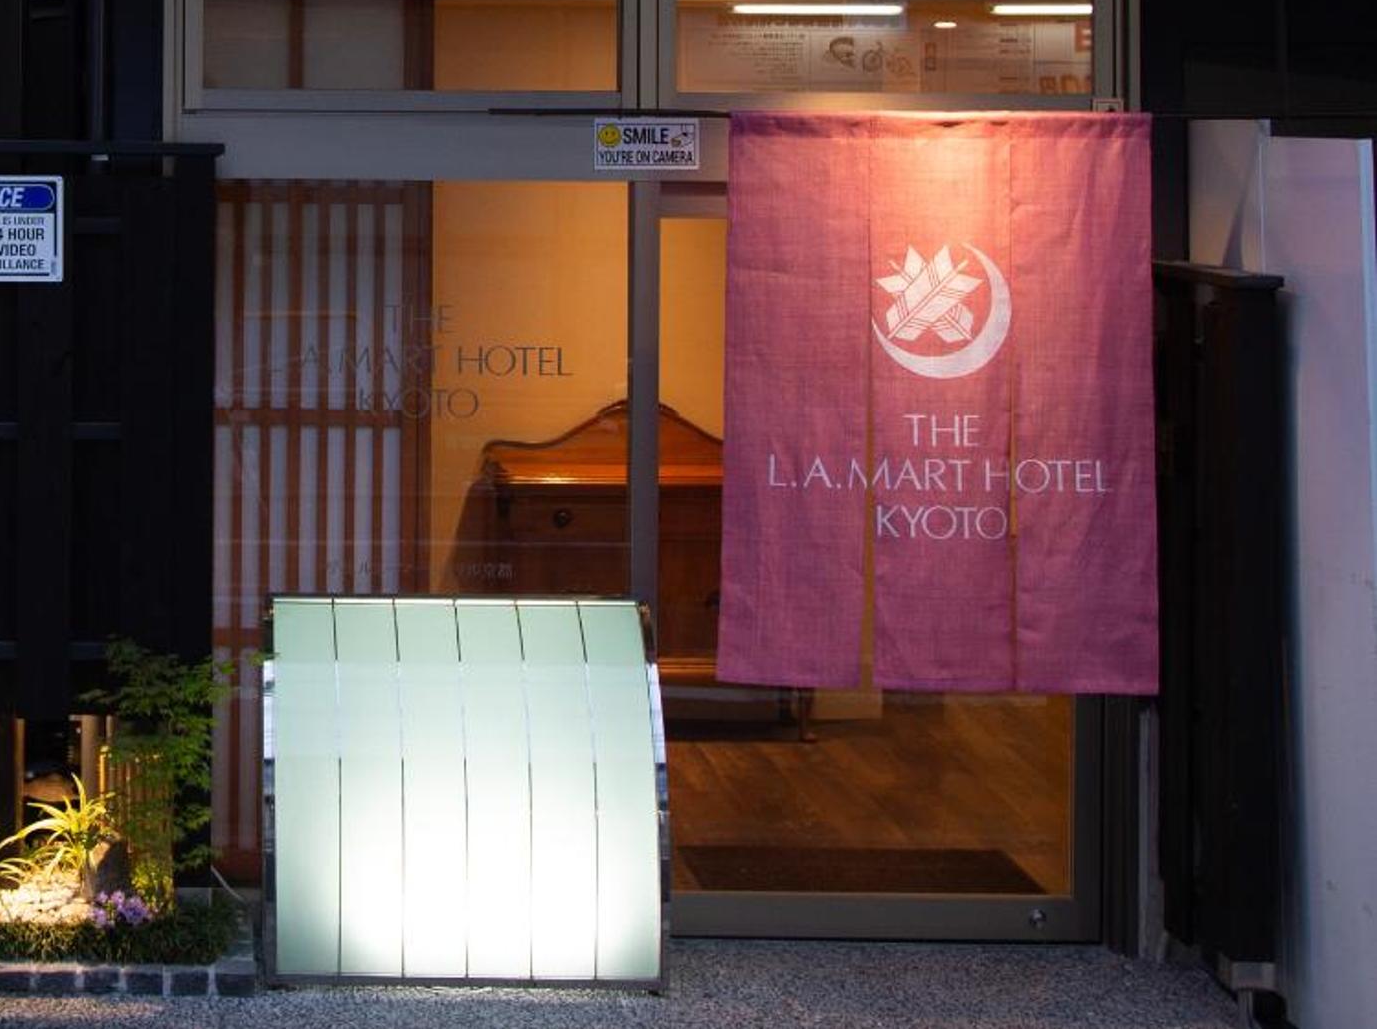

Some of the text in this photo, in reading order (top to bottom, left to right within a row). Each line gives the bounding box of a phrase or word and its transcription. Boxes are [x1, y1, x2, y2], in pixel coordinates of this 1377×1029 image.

[623, 128, 670, 145] SMILE
[598, 150, 693, 163] YOU'RE ON CAMERA
[7, 227, 45, 241] HOUR
[267, 344, 574, 376] LA.MART HOTEL
[358, 388, 479, 420] KYOTO
[902, 414, 981, 447] THE
[767, 453, 1114, 493] L.A.MART HOTEL
[875, 505, 1008, 540] KYOTO
